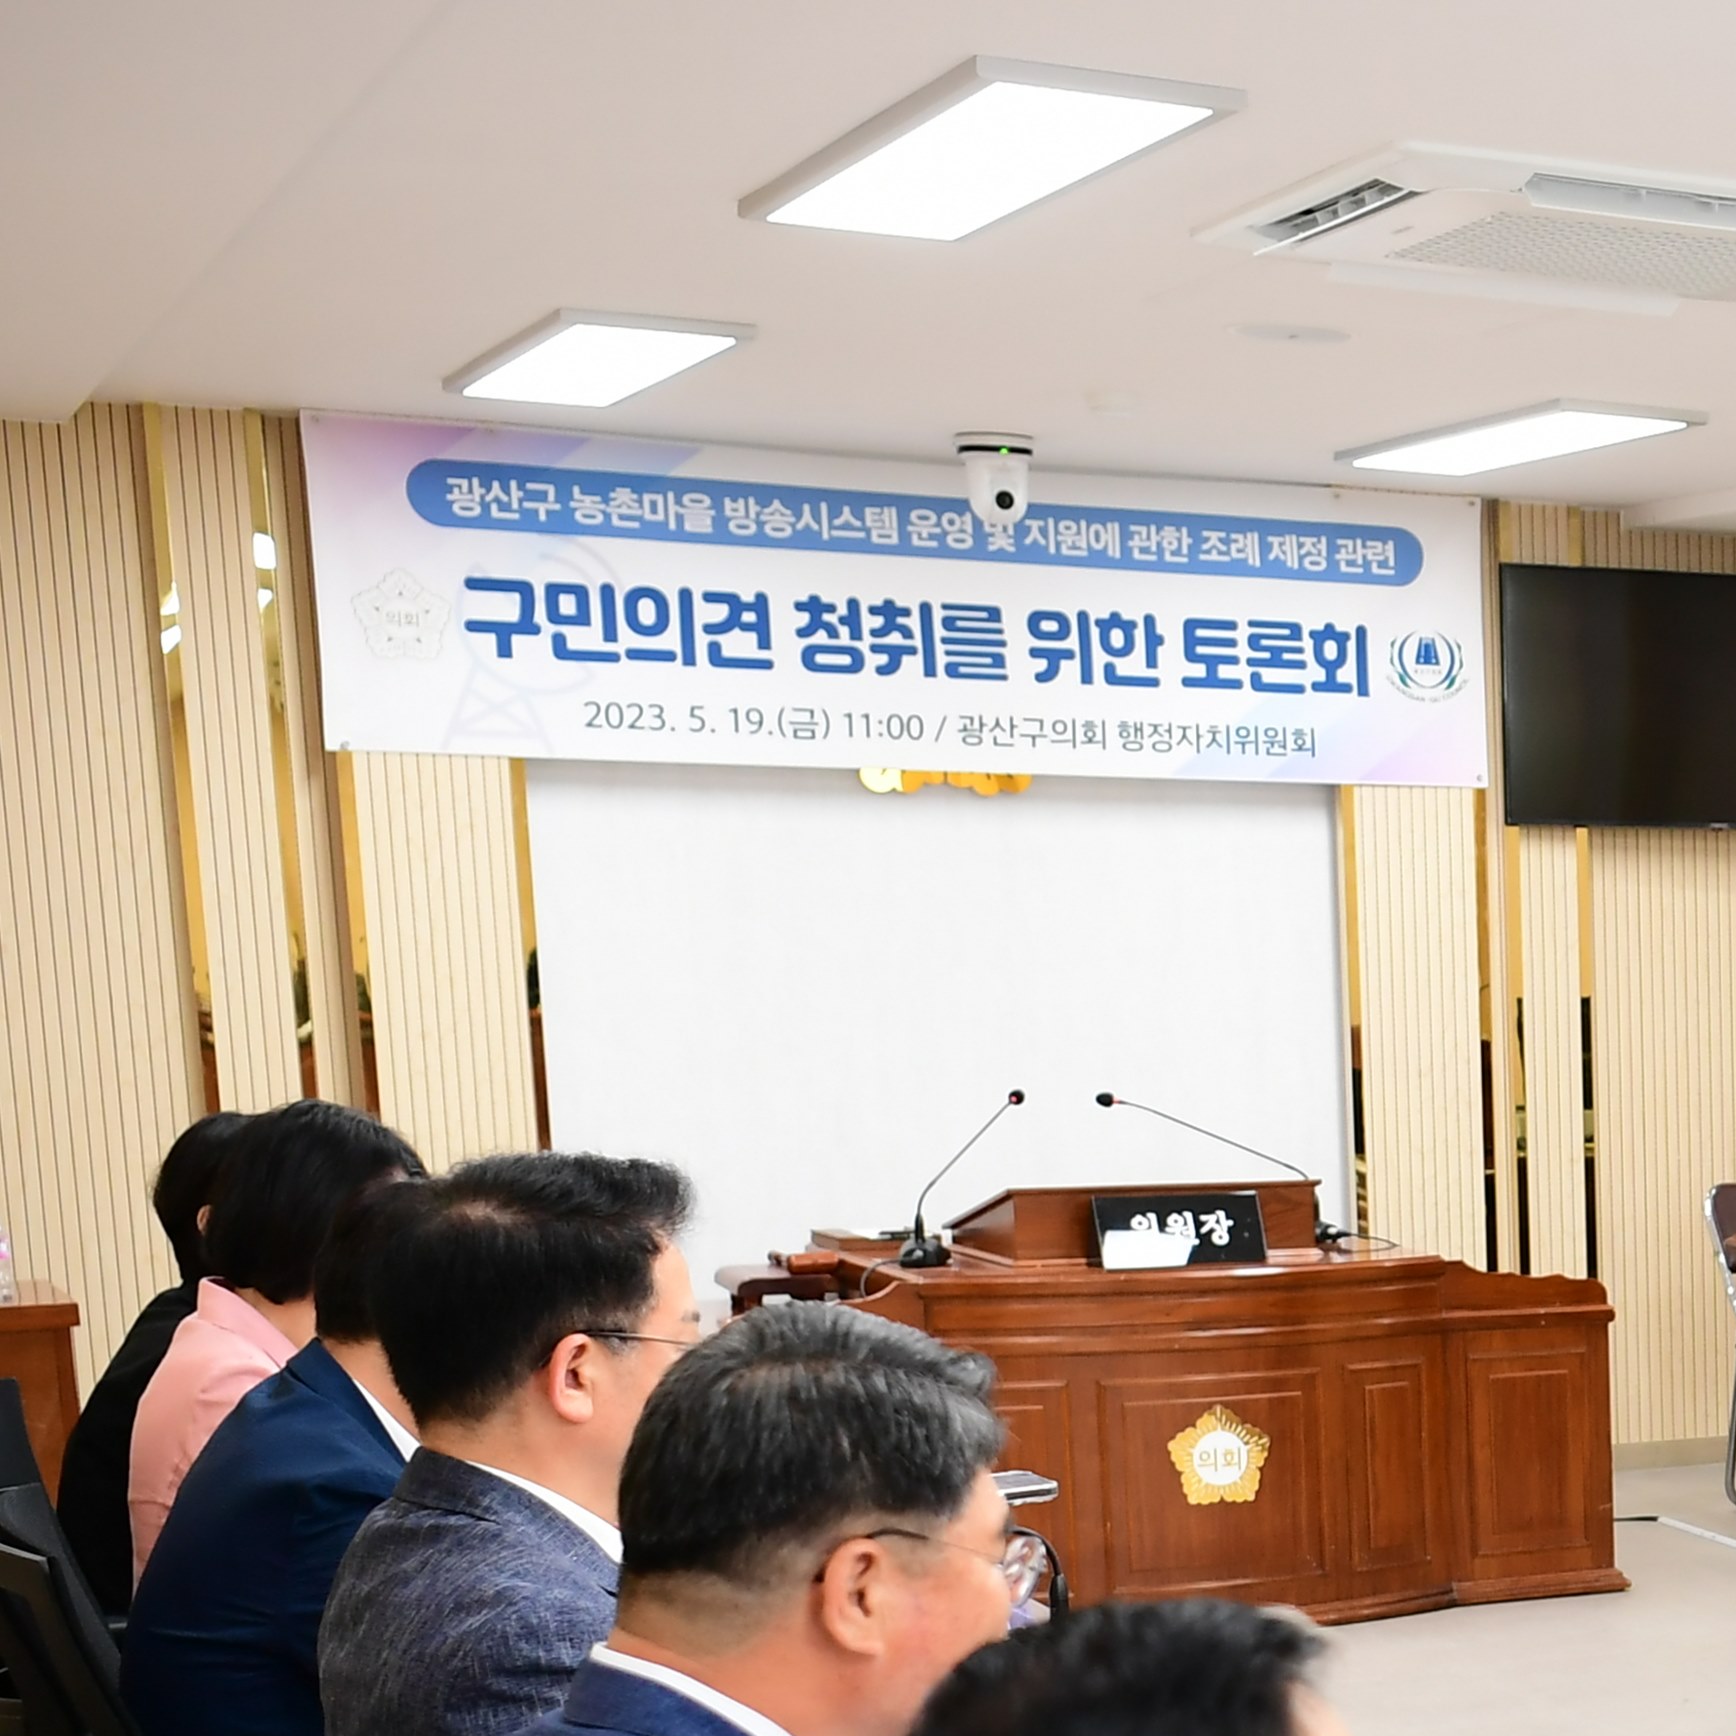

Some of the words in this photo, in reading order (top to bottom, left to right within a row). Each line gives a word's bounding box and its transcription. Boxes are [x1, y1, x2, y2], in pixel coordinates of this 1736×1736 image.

[445, 477, 561, 521] 광산구
[570, 486, 714, 533] 농촌마을
[723, 497, 900, 545] 방송시스템
[907, 508, 974, 550] 운영
[1023, 517, 1119, 559] 지원에
[1128, 526, 1192, 564] 관한
[1199, 532, 1261, 568] 조례
[1267, 535, 1330, 572] 제정
[1334, 539, 1397, 576] 관련
[463, 575, 775, 671] 구민의견
[793, 593, 1009, 681] 청취를
[1026, 608, 1164, 688] 위한
[1181, 617, 1370, 698] 토론회
[584, 700, 677, 733] 2023.
[689, 706, 716, 735] 5.
[729, 706, 831, 740] 19.(금)
[843, 711, 924, 742] 11:00
[956, 716, 1108, 750] 광산구의회
[1117, 720, 1317, 758] 행정자치위원회
[1197, 1446, 1242, 1472] 의회
